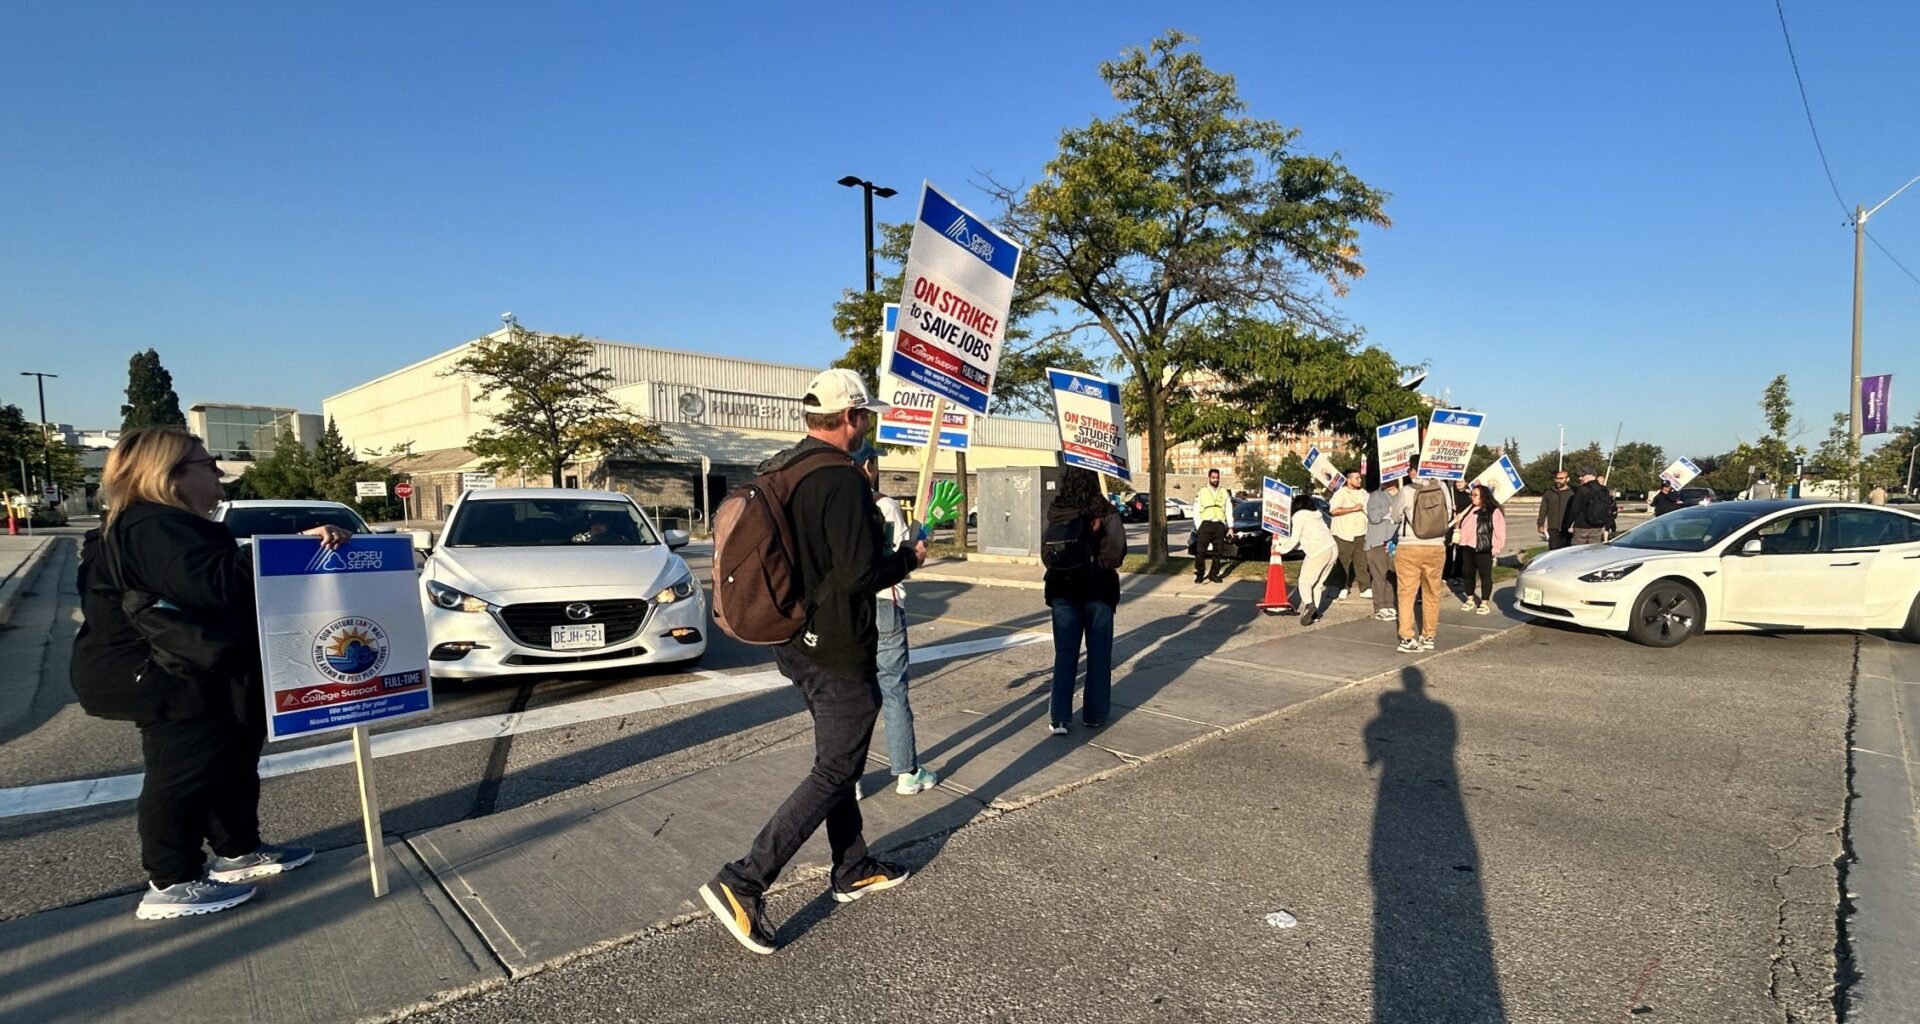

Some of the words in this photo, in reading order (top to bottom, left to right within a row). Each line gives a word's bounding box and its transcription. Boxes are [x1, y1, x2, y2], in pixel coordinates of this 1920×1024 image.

[914, 276, 941, 307] ON
[939, 290, 998, 339] STRIKE!
[910, 302, 921, 319] to
[920, 311, 960, 345] SAVE
[957, 331, 992, 362] JOBS
[711, 400, 782, 419] HUMBER
[1064, 411, 1078, 423] ON
[1080, 415, 1119, 435] STRIKE!
[1073, 434, 1115, 453] SUPPORTS
[1078, 426, 1122, 446] STUDENT
[1436, 448, 1469, 457] STUDENT
[347, 551, 382, 561] OPSEU
[347, 560, 383, 570] SEFPO
[319, 629, 332, 641] OUR
[330, 619, 354, 631] FUTURE
[355, 619, 373, 629] CAN'T
[371, 626, 384, 640] WAIT
[554, 631, 579, 644] DEJH
[584, 629, 602, 642] 521
[319, 662, 338, 678] AVENIR
[338, 673, 346, 681] NE
[346, 674, 361, 682] PEUT
[362, 668, 376, 679] PLUS
[301, 691, 340, 704] College
[340, 685, 378, 699] Support
[384, 672, 421, 689] FULL-TIME
[342, 704, 361, 714] work
[361, 701, 373, 711] for
[309, 717, 330, 726] Nous
